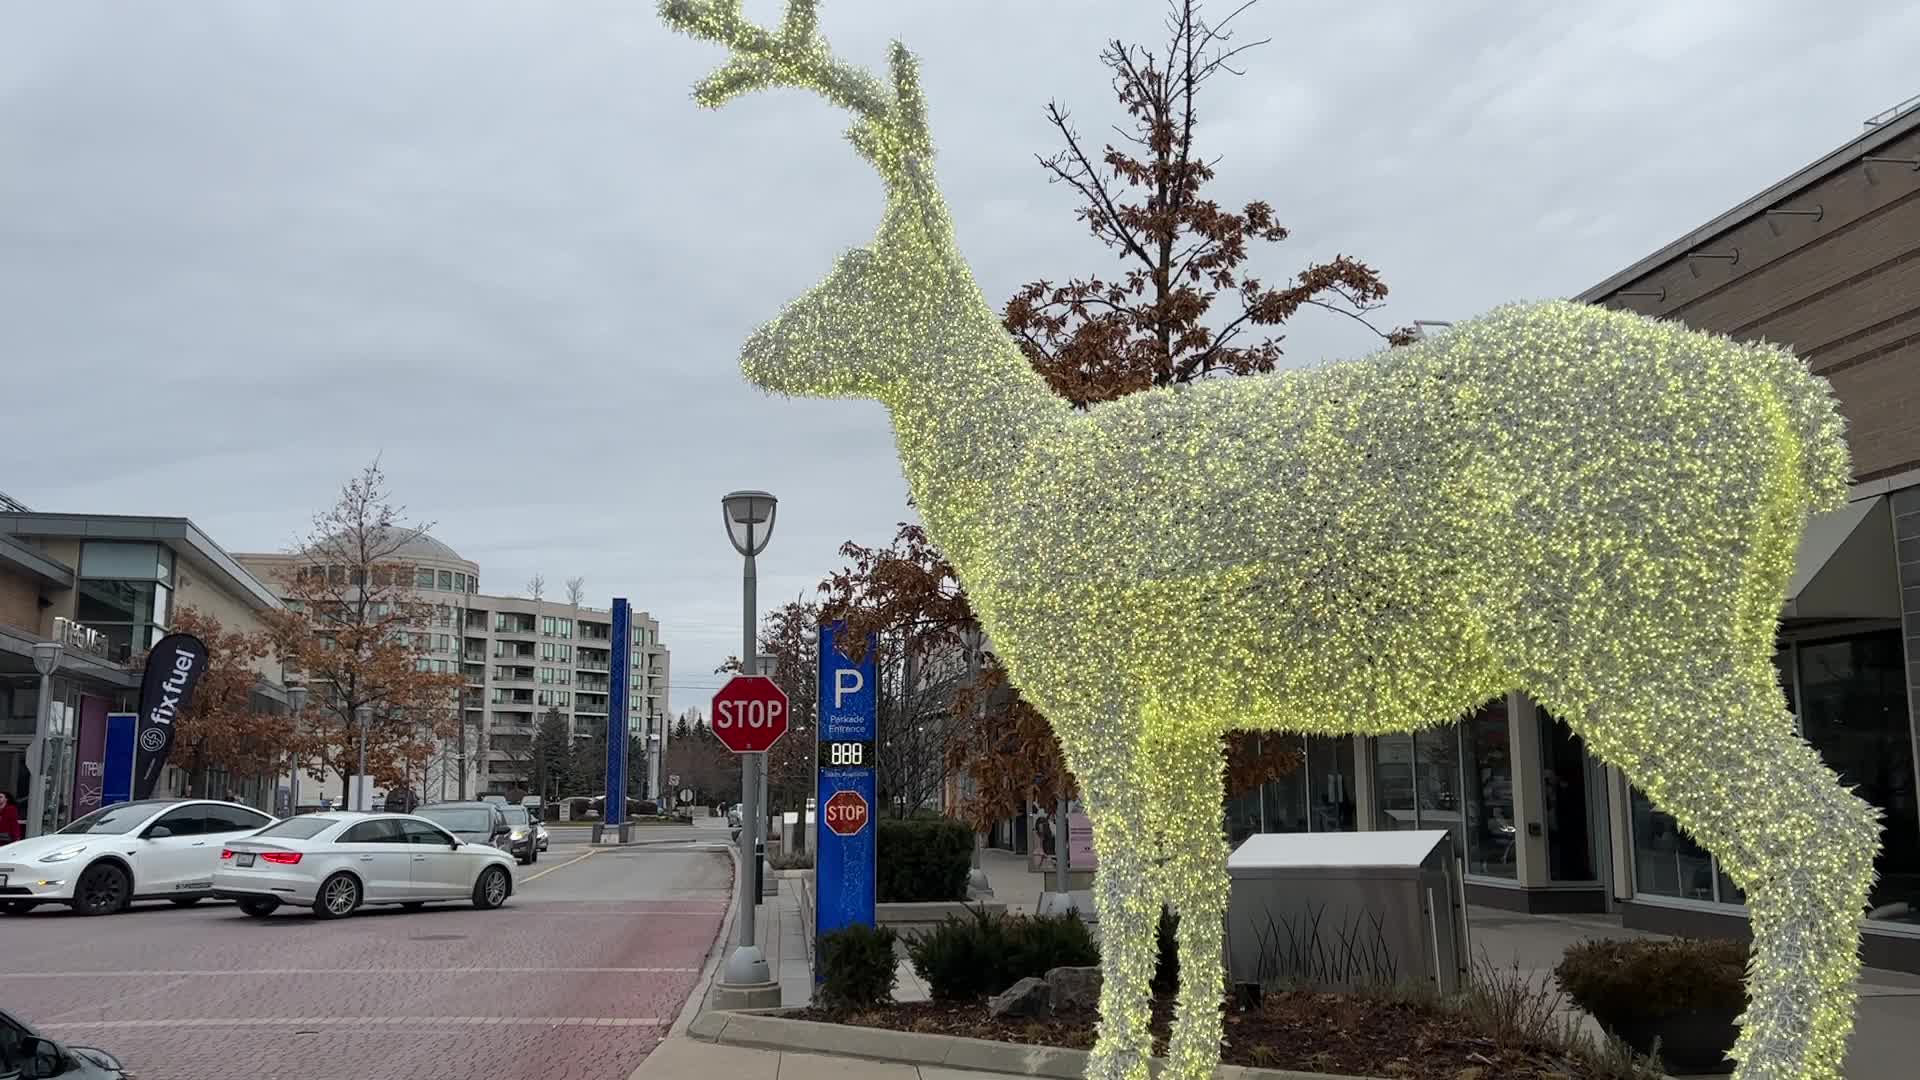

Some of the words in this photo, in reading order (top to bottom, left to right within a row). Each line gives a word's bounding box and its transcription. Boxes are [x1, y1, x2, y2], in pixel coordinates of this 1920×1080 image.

[162, 649, 195, 694] fuel
[835, 668, 864, 708] P
[151, 695, 179, 725] fix
[718, 700, 782, 728] STOP
[830, 715, 865, 724] Parkade
[829, 725, 866, 733] Entrance
[831, 742, 862, 765] 888
[828, 804, 865, 822] STOP
